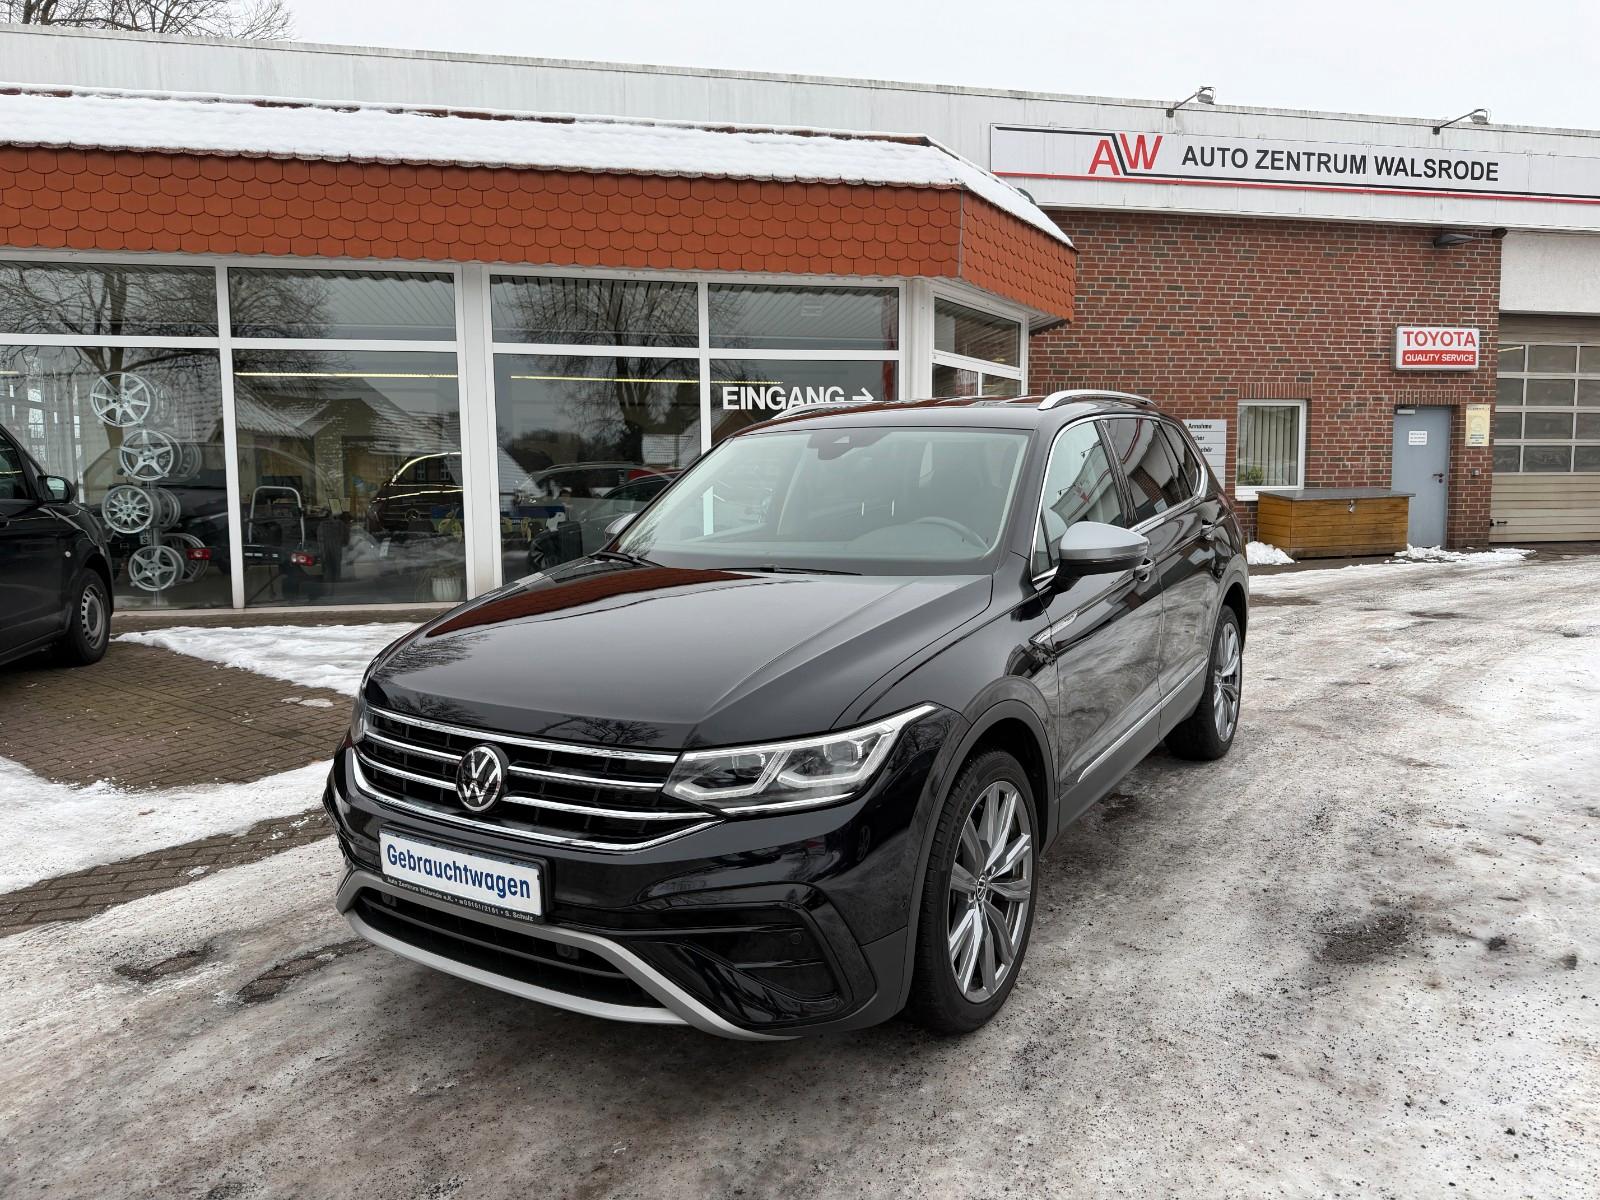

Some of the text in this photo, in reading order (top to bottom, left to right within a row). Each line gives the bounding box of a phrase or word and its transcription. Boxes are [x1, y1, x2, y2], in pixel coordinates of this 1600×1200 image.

[1088, 133, 1163, 176] AW
[1181, 145, 1499, 182] AUTO ZENTRUM WALSRODE
[1402, 330, 1477, 347] TOYOTA
[1404, 353, 1474, 362] QUALITY SERVICE
[722, 386, 845, 410] EINGANG
[387, 843, 531, 899] Gebrauchtwagen
